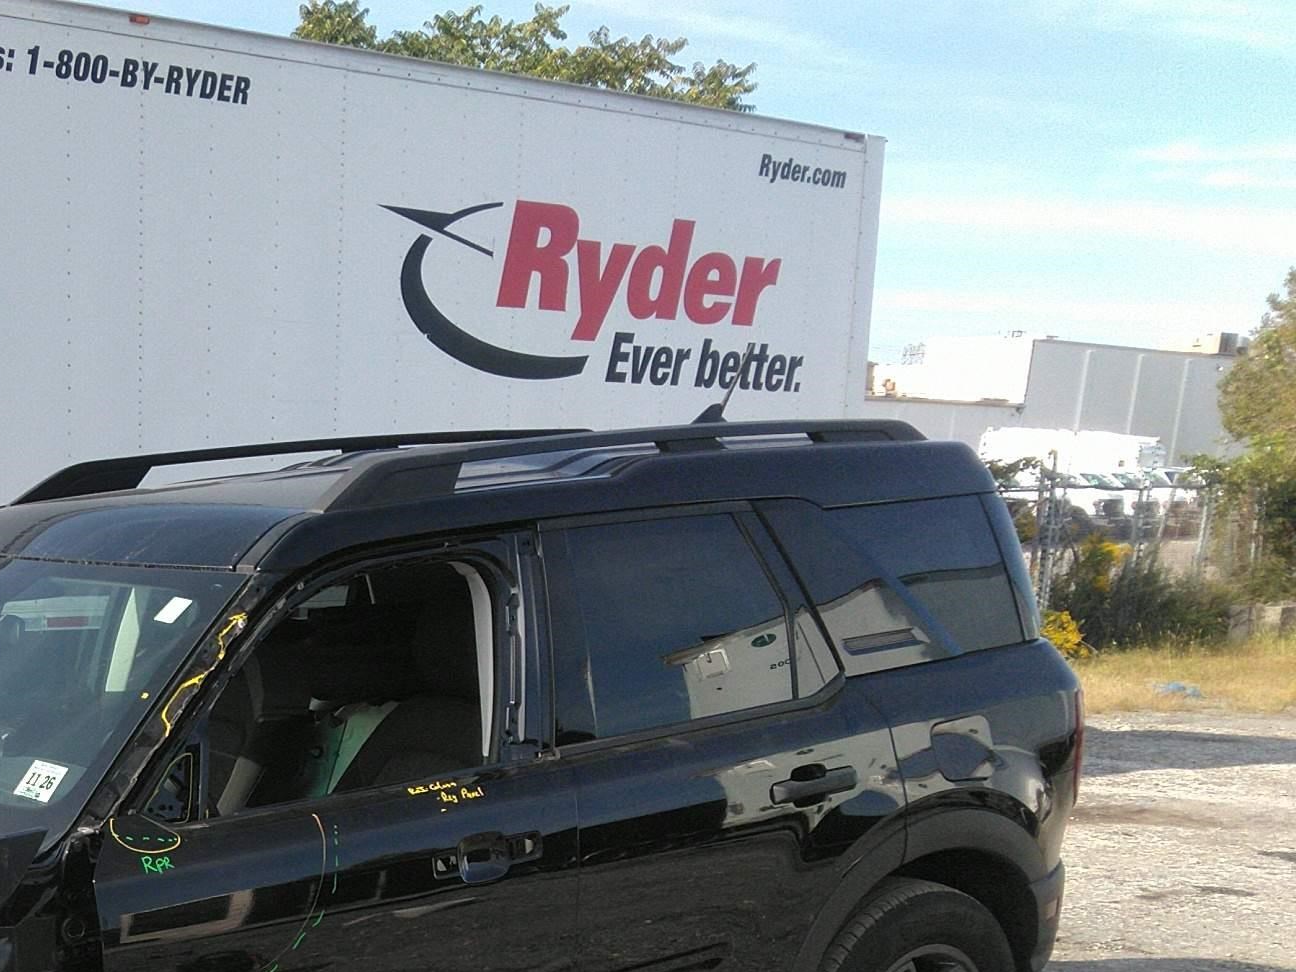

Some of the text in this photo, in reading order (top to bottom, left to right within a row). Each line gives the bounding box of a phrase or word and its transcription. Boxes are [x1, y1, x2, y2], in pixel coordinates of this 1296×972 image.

[27, 45, 251, 105] 1-800-BY-RYDER
[758, 152, 847, 190] Ryder.com
[495, 199, 782, 342] Ryder
[604, 331, 805, 393] Ever better.
